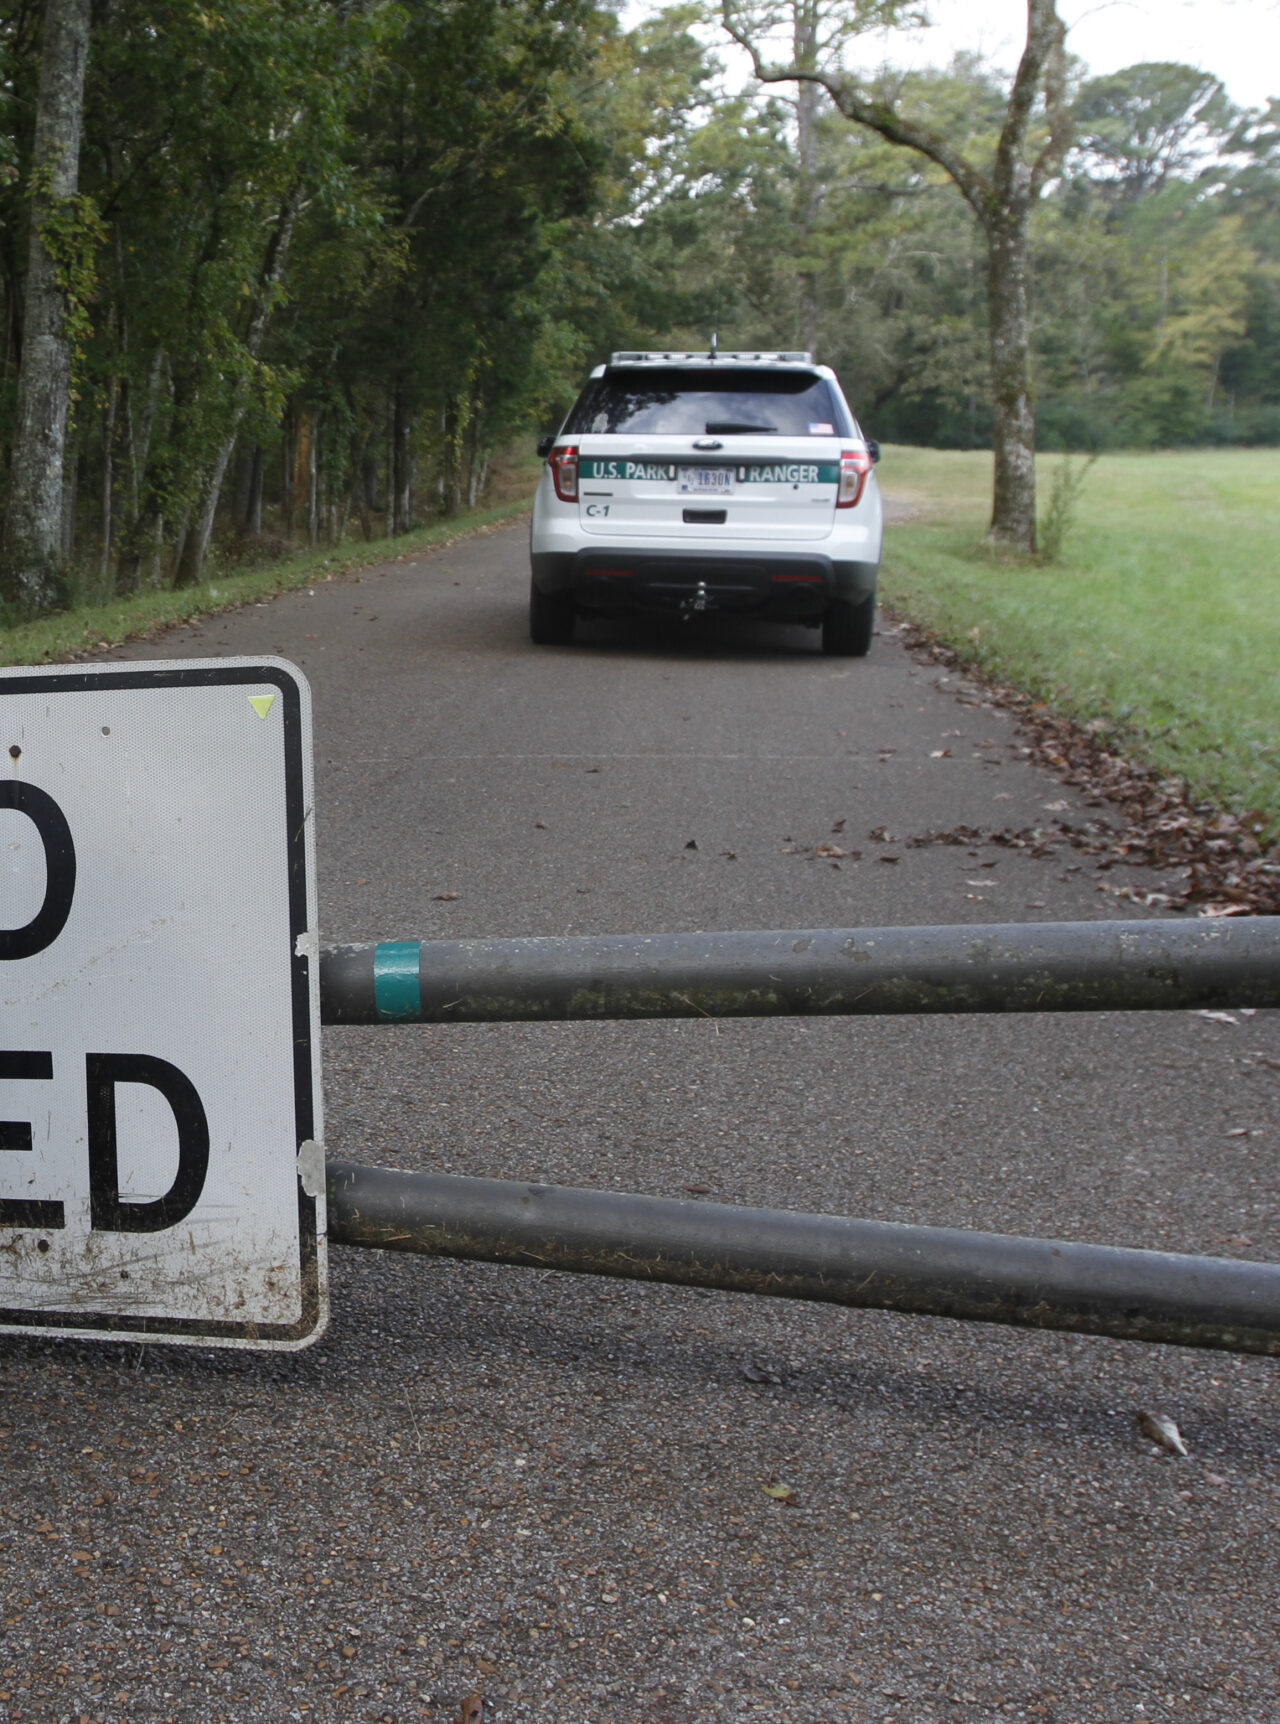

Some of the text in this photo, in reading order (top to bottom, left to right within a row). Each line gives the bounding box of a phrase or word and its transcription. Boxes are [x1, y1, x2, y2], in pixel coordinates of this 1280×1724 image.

[592, 462, 819, 483] U.S. PARK RANGER
[586, 504, 610, 518] C-1
